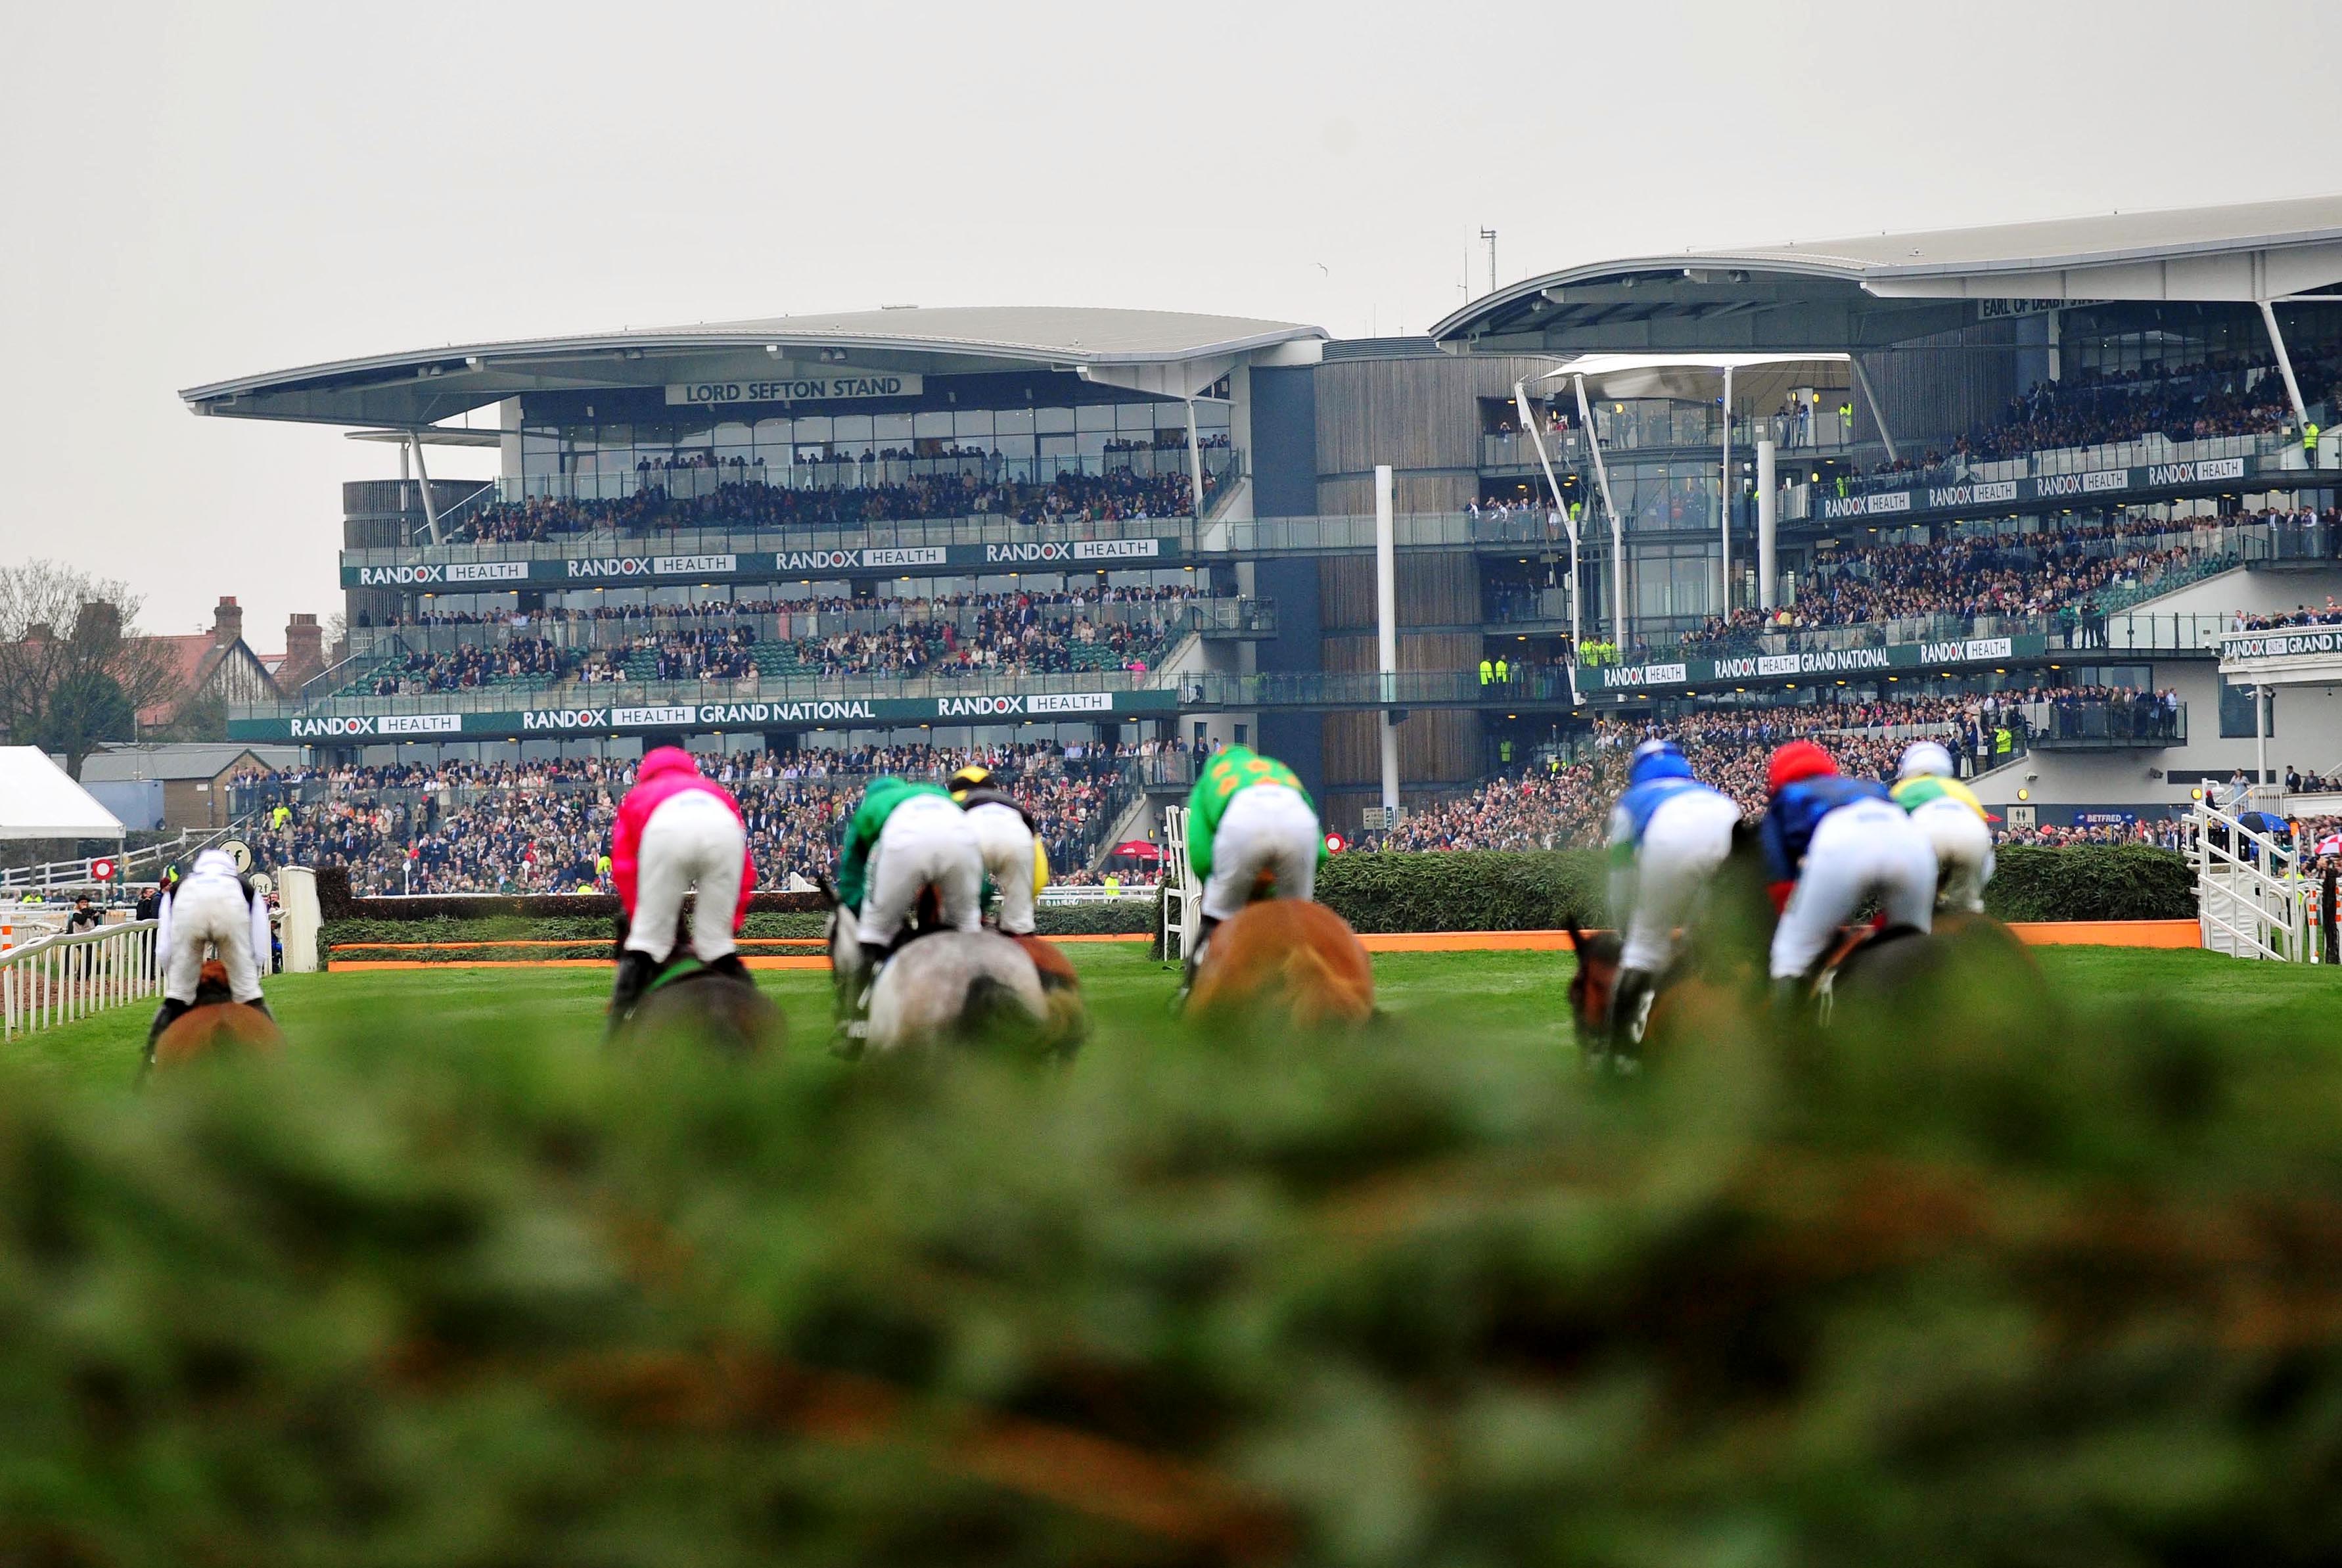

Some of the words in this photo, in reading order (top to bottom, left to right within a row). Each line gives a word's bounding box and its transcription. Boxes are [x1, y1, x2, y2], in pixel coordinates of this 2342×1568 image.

[687, 384, 741, 402] LORD
[748, 380, 825, 399] SEFTON
[834, 377, 902, 396] STAND
[2038, 474, 2082, 496] RANDOX
[2088, 473, 2123, 489] HEALTH
[2149, 462, 2195, 486] RANDOX
[2203, 461, 2238, 478] HEALTH
[1825, 496, 1867, 518] RANDOX
[1873, 494, 1906, 511] HEALTH
[1929, 485, 1972, 507] RANDOX
[1979, 484, 2011, 500] HEALTH
[776, 550, 859, 570] RANDOX
[873, 549, 937, 565] HEALTH
[986, 542, 1070, 563] RANDOX
[1084, 541, 1149, 557] HEALTH
[360, 565, 443, 586] RANDOX
[455, 565, 519, 580] HEALTH
[568, 557, 650, 578] RANDOX
[664, 557, 727, 572] HEALTH
[1921, 641, 1965, 663] RANDOX
[1972, 641, 2006, 657] HEALTH
[2224, 639, 2264, 657] RANDOX
[2288, 634, 2332, 653] GRAND
[1715, 657, 1756, 678] RANDOX
[1763, 657, 1795, 672] HEALTH
[1801, 651, 1836, 672] GRAND
[1837, 648, 1890, 669] NATIONAL
[1604, 666, 1645, 687] RANDOX
[1650, 666, 1681, 681] HEALTH
[522, 708, 607, 729] RANDOX
[622, 709, 686, 724] HEALTH
[699, 703, 768, 724] GRAND
[772, 699, 875, 721] NATIONAL
[938, 695, 1024, 716] RANDOX
[1038, 694, 1102, 710] HEALTH
[290, 716, 375, 737] RANDOX
[388, 716, 451, 731] HEALTH
